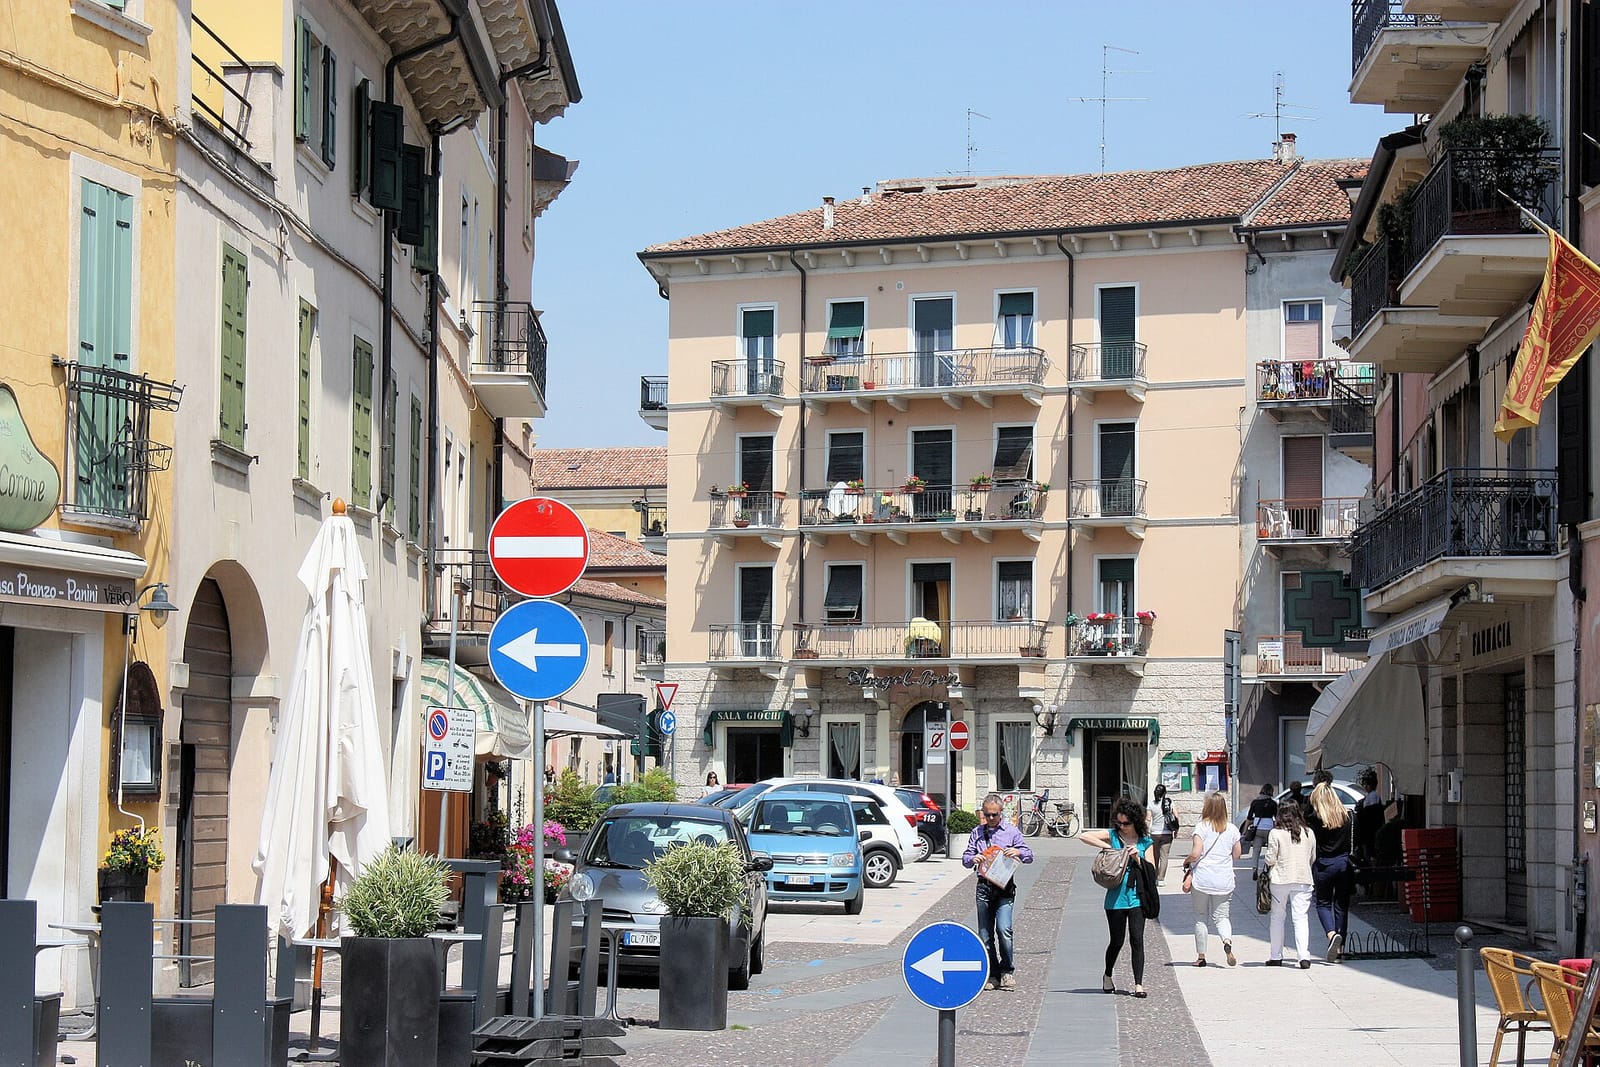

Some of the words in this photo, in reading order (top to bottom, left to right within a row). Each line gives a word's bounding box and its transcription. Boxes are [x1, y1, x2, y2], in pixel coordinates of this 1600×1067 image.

[0, 464, 45, 502] Corone
[17, 572, 56, 600] Pranzo
[66, 578, 98, 603] Panini
[103, 588, 132, 606] VERO
[717, 711, 741, 720] SALA
[746, 711, 781, 721] GIOCHI
[1077, 719, 1104, 729] SALA
[1105, 719, 1149, 729] BILIARDI
[430, 754, 444, 777] P
[923, 814, 936, 823] 112
[630, 934, 639, 943] CL
[640, 934, 660, 944] 710P
